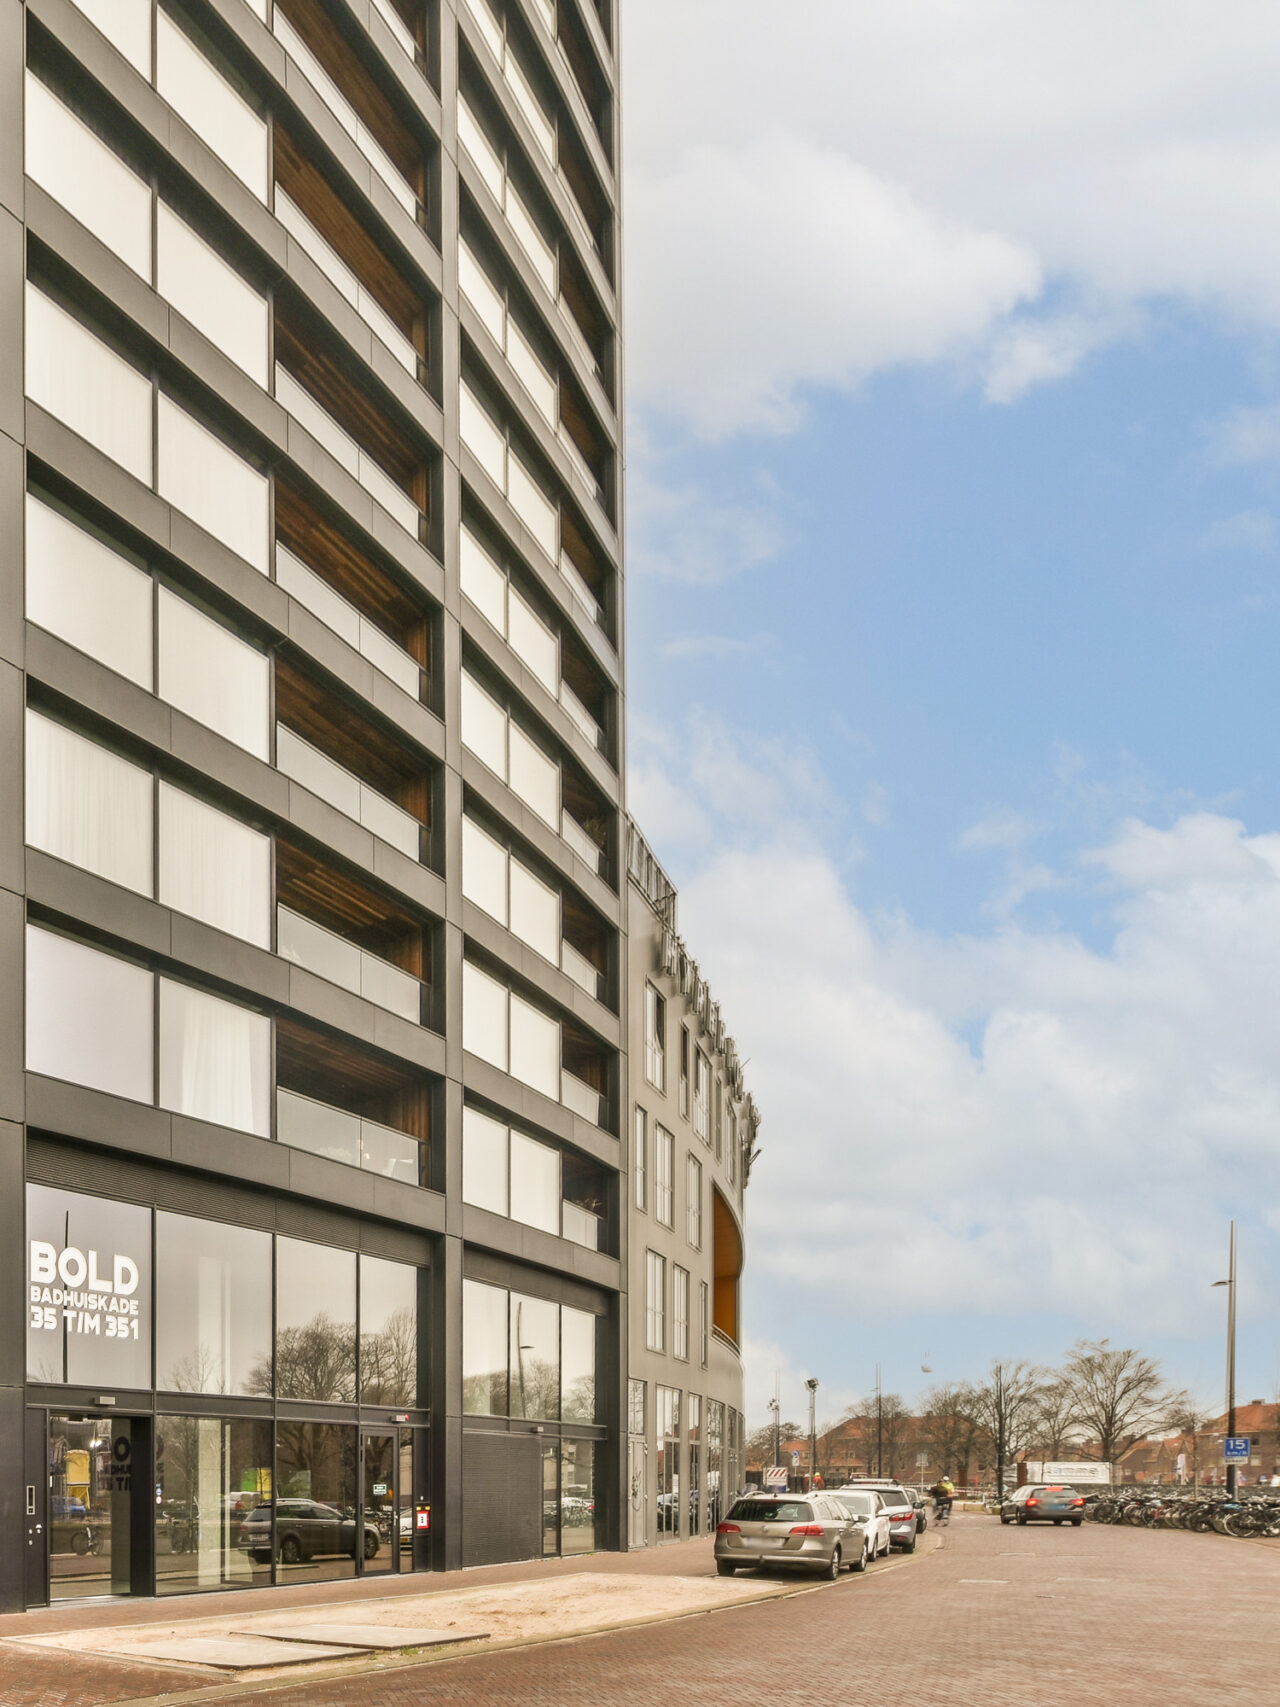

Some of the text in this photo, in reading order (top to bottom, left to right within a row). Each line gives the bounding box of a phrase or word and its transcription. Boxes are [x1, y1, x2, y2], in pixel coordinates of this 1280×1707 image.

[30, 1240, 139, 1296] BOLD
[30, 1285, 139, 1315] BADHUISKADE
[30, 1305, 58, 1330] 35
[105, 1314, 139, 1340] 351
[1228, 1440, 1246, 1449] 15
